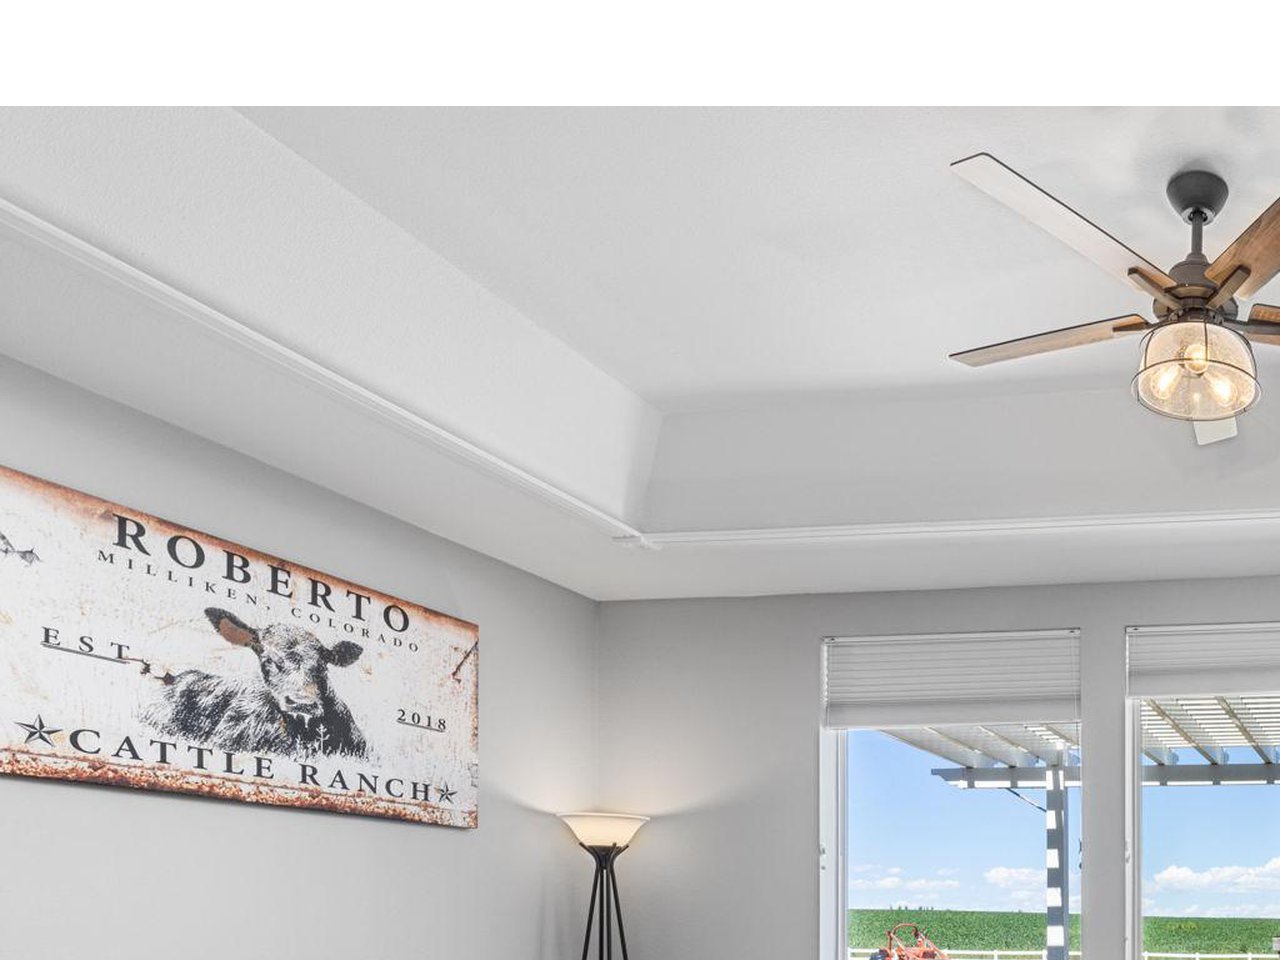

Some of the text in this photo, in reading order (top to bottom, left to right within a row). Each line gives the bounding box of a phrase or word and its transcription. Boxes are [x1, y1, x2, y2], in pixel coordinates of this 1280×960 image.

[98, 549, 419, 653] MILLIKEN, COLORADO
[112, 513, 410, 633] ROBERTO
[397, 708, 447, 730] 2018
[69, 729, 431, 802] CATTLE RANCH
